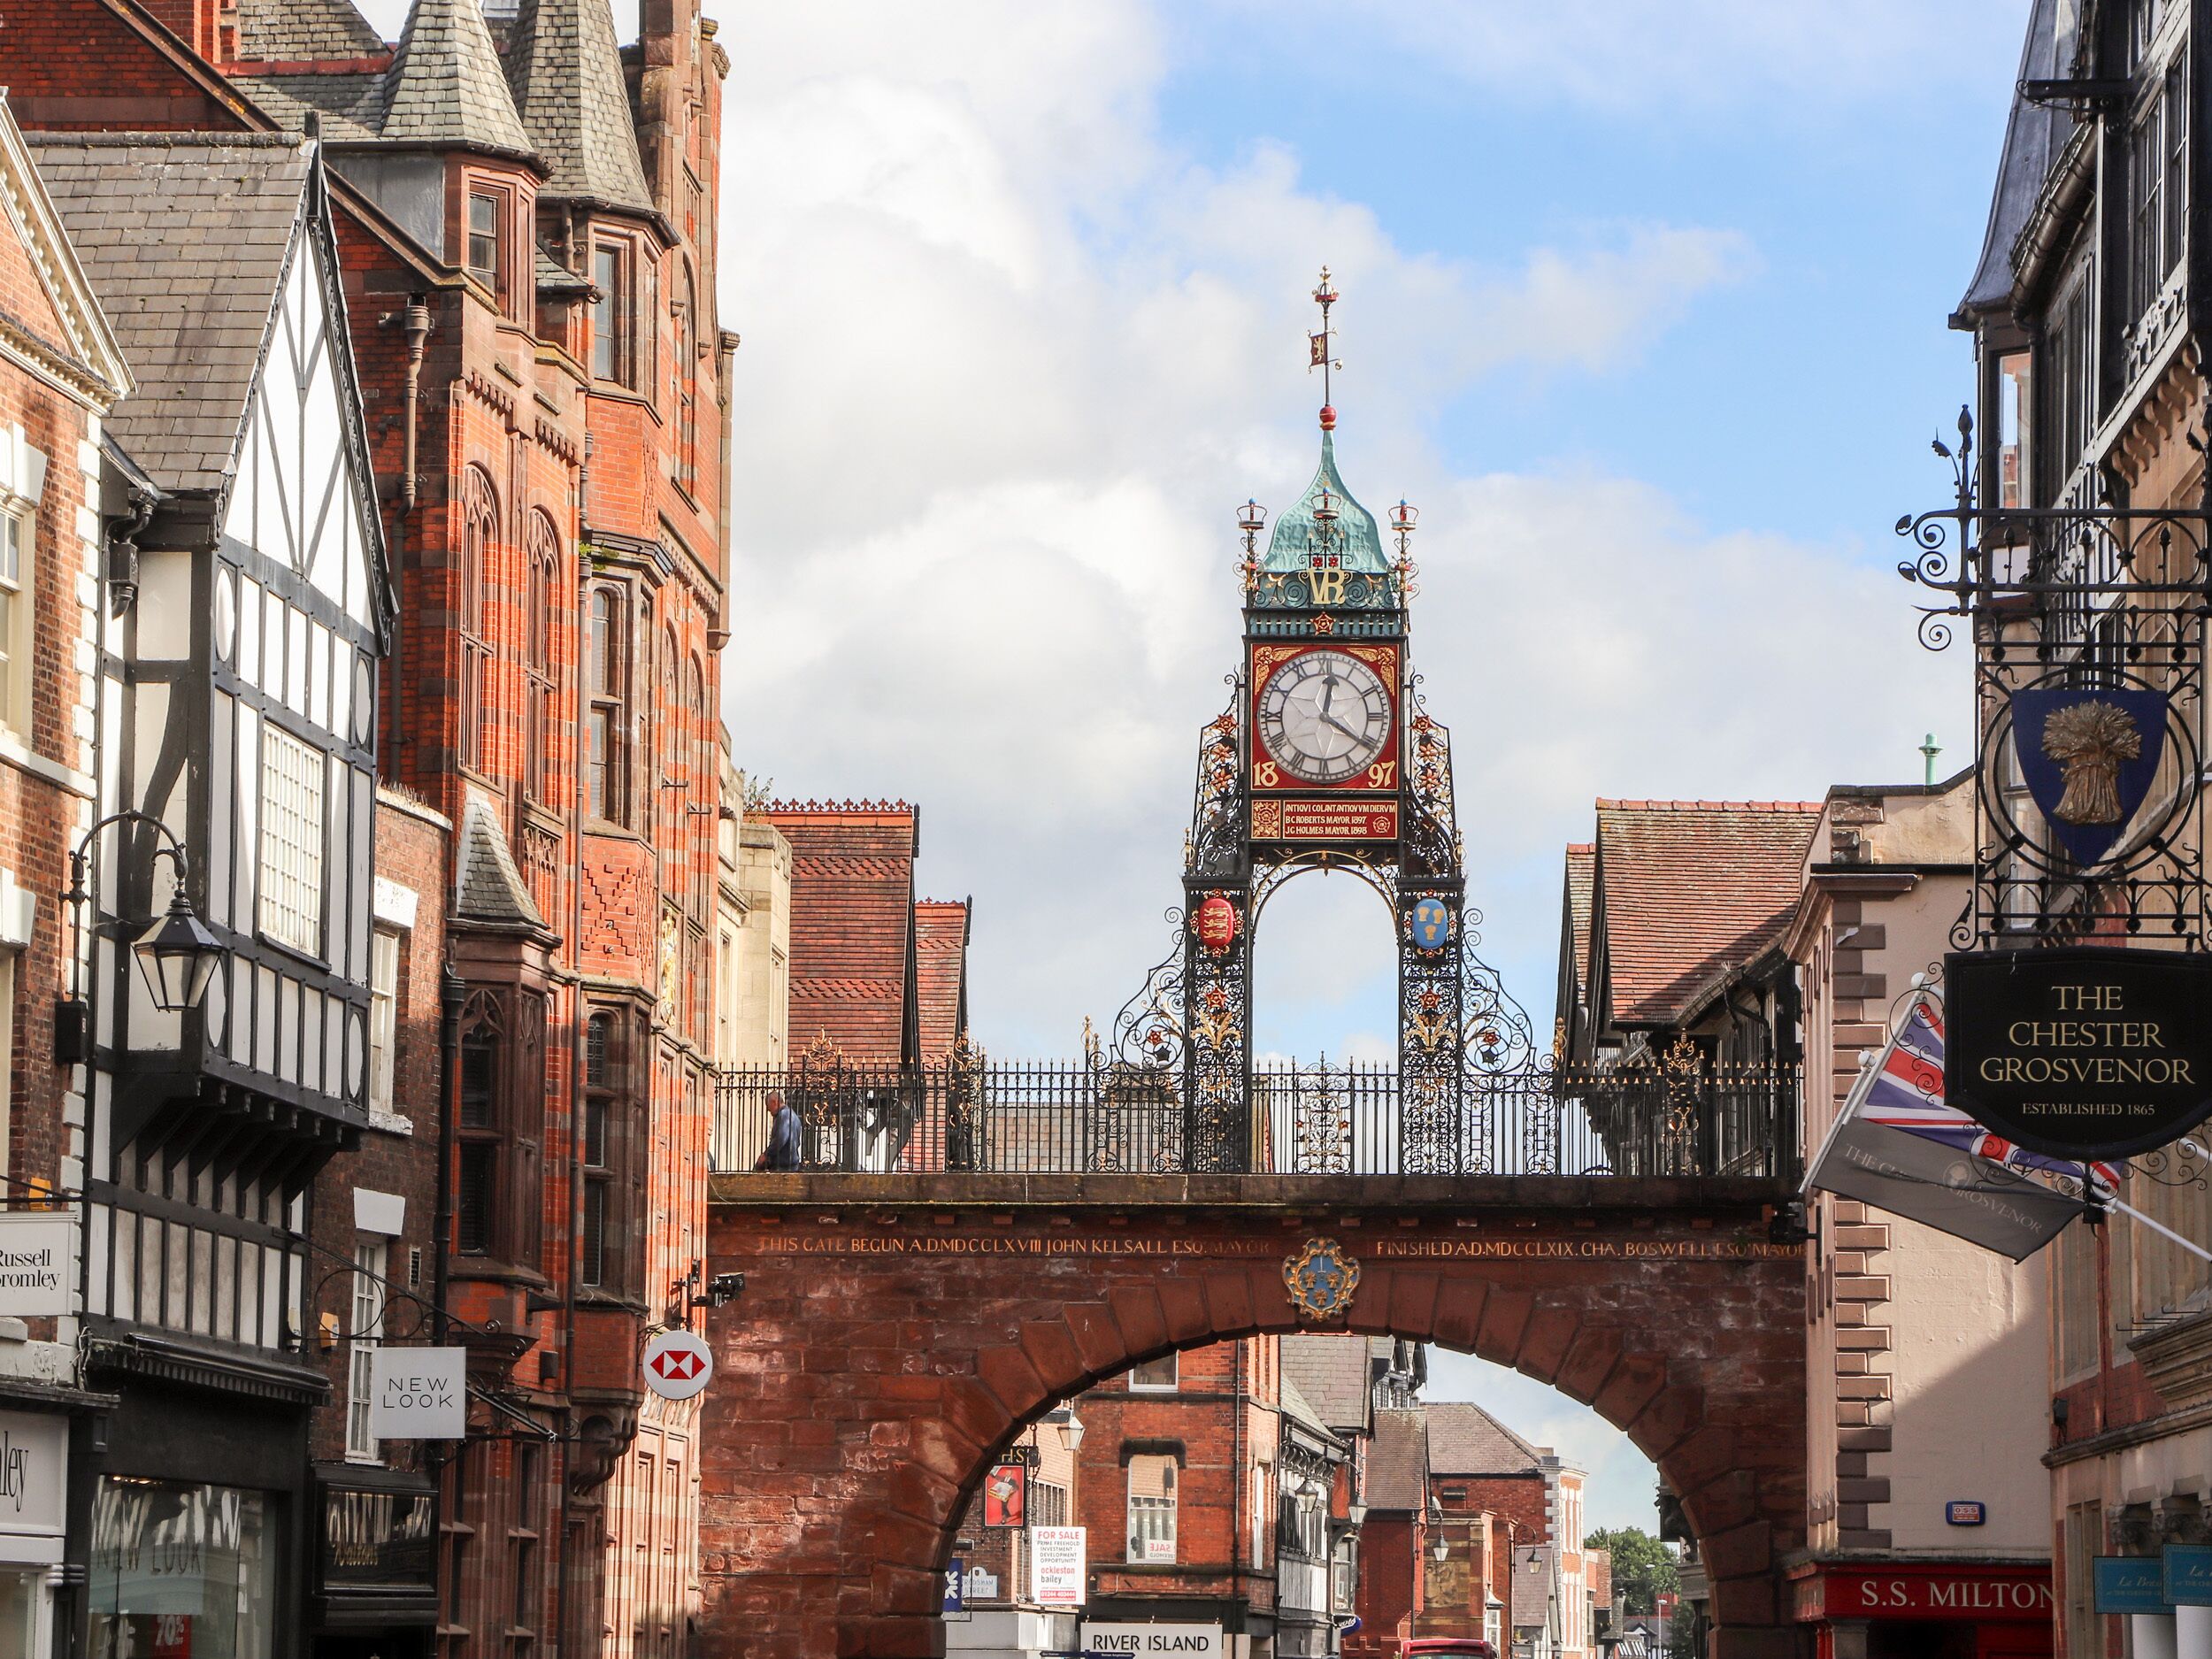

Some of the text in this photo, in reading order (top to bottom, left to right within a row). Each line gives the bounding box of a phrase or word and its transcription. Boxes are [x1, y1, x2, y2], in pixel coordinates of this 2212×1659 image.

[1253, 761, 1279, 787] 18
[1368, 760, 1396, 787] 97
[2051, 986, 2124, 1010] THE
[2008, 1021, 2166, 1048] CHESTER
[1980, 1057, 2196, 1084] GROSVENOR
[2022, 1102, 2155, 1116] ESTABLISHED 1865
[759, 1237, 797, 1251] THIS
[803, 1238, 845, 1252] GATE
[851, 1238, 904, 1252] BEGUN
[1046, 1239, 1087, 1256] JOHN
[1092, 1239, 1167, 1254] KELSALL
[1377, 1241, 1452, 1256] FINISHED
[1625, 1242, 1711, 1256] BOSWELL
[0, 1270, 60, 1291] romley
[388, 1378, 448, 1392] NEW
[383, 1394, 453, 1408] LOOK
[0, 1430, 28, 1512] ley
[1038, 1531, 1079, 1540] FOR SALE
[1041, 1565, 1075, 1574] ockleston
[1041, 1575, 1063, 1584] bailey
[1861, 1580, 1916, 1607] S.S.
[1093, 1634, 1210, 1651] RIVER ISLAND
